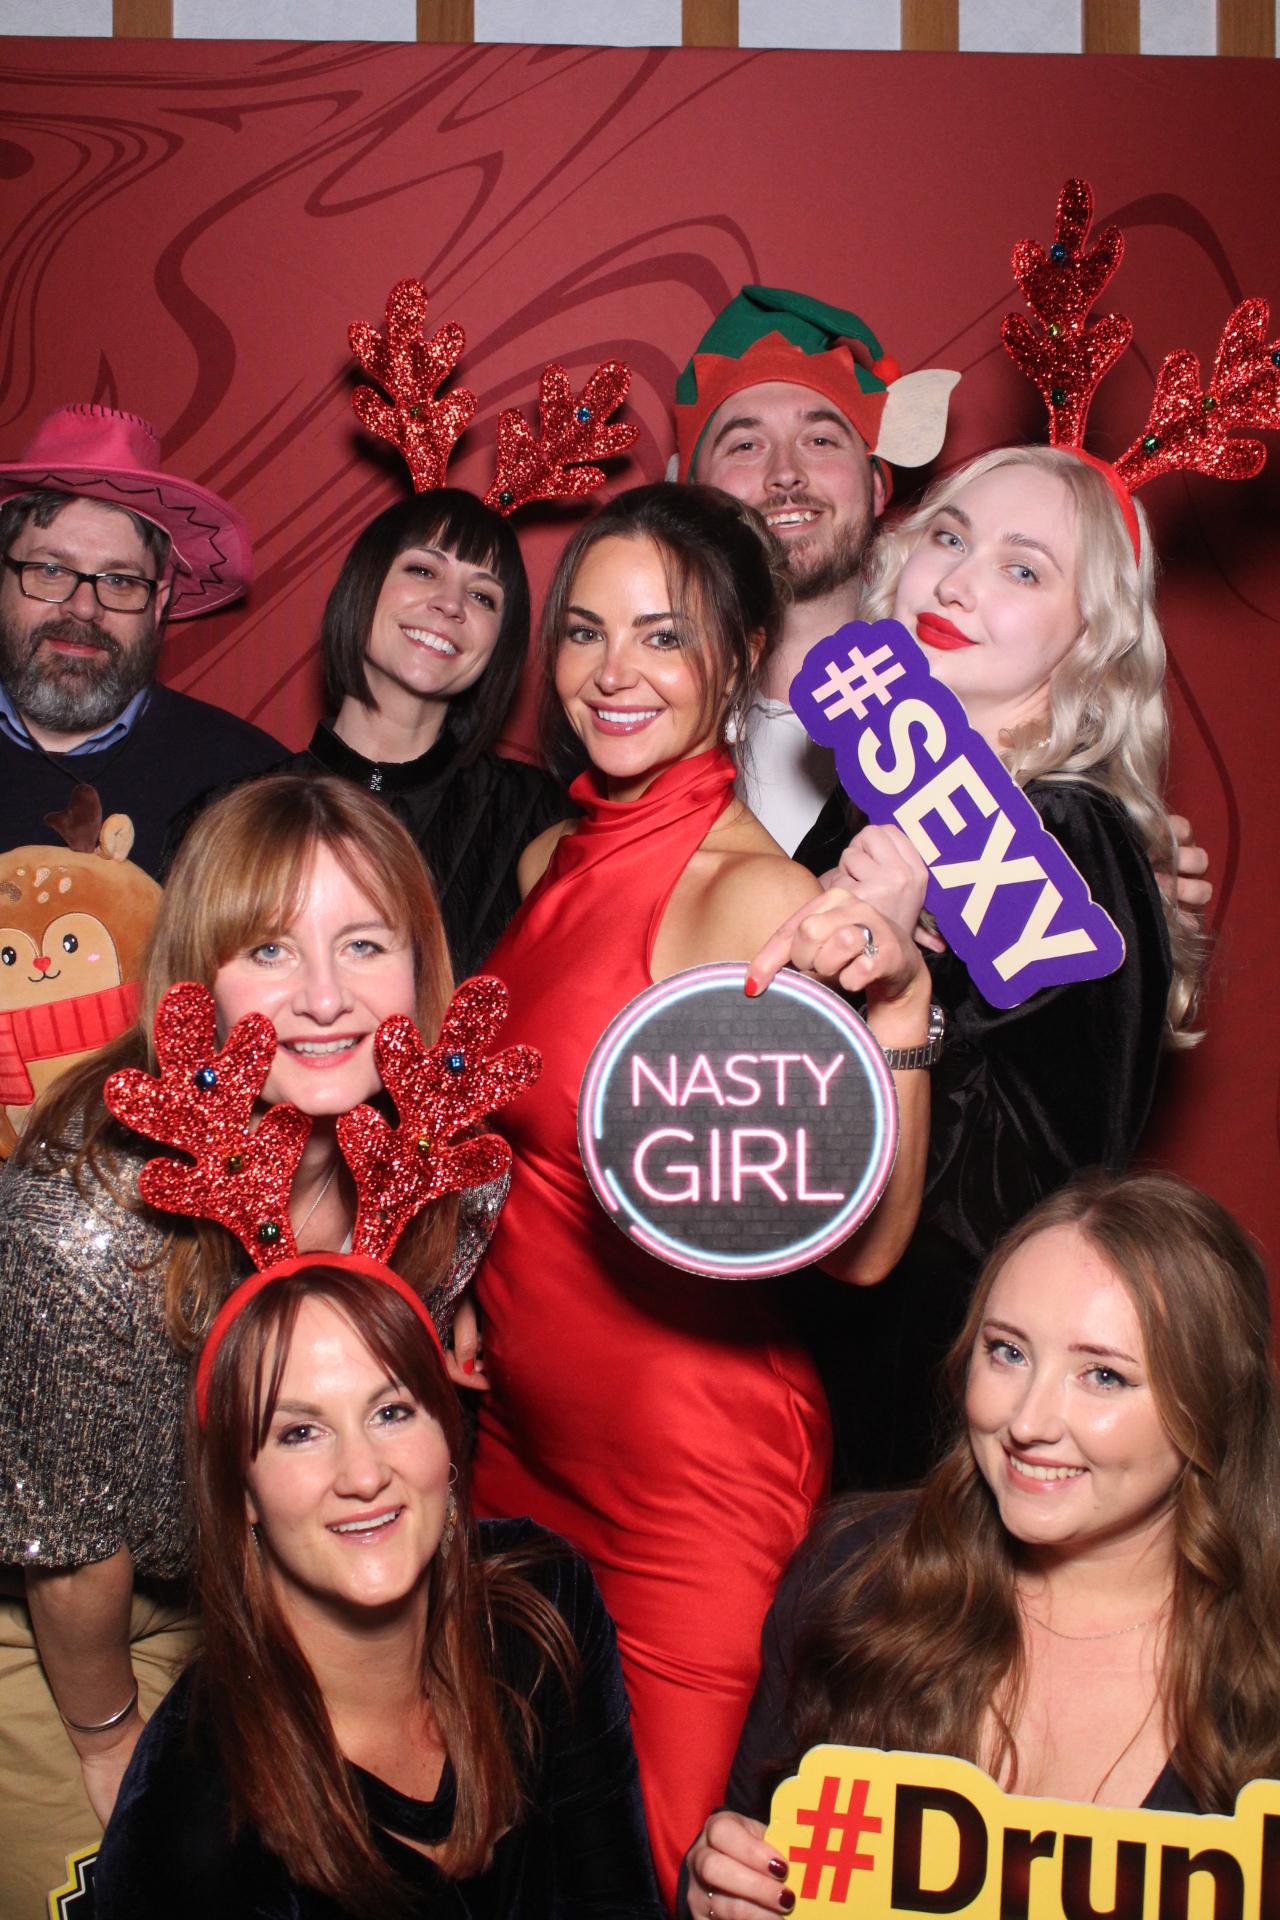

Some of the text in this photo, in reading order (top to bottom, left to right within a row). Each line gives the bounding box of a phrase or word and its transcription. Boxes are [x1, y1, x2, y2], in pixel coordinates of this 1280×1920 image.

[811, 644, 1098, 982] #SEXY
[632, 1054, 844, 1106] NASTY
[633, 1128, 845, 1202] GIRL
[788, 1775, 1280, 1920] #Drun
